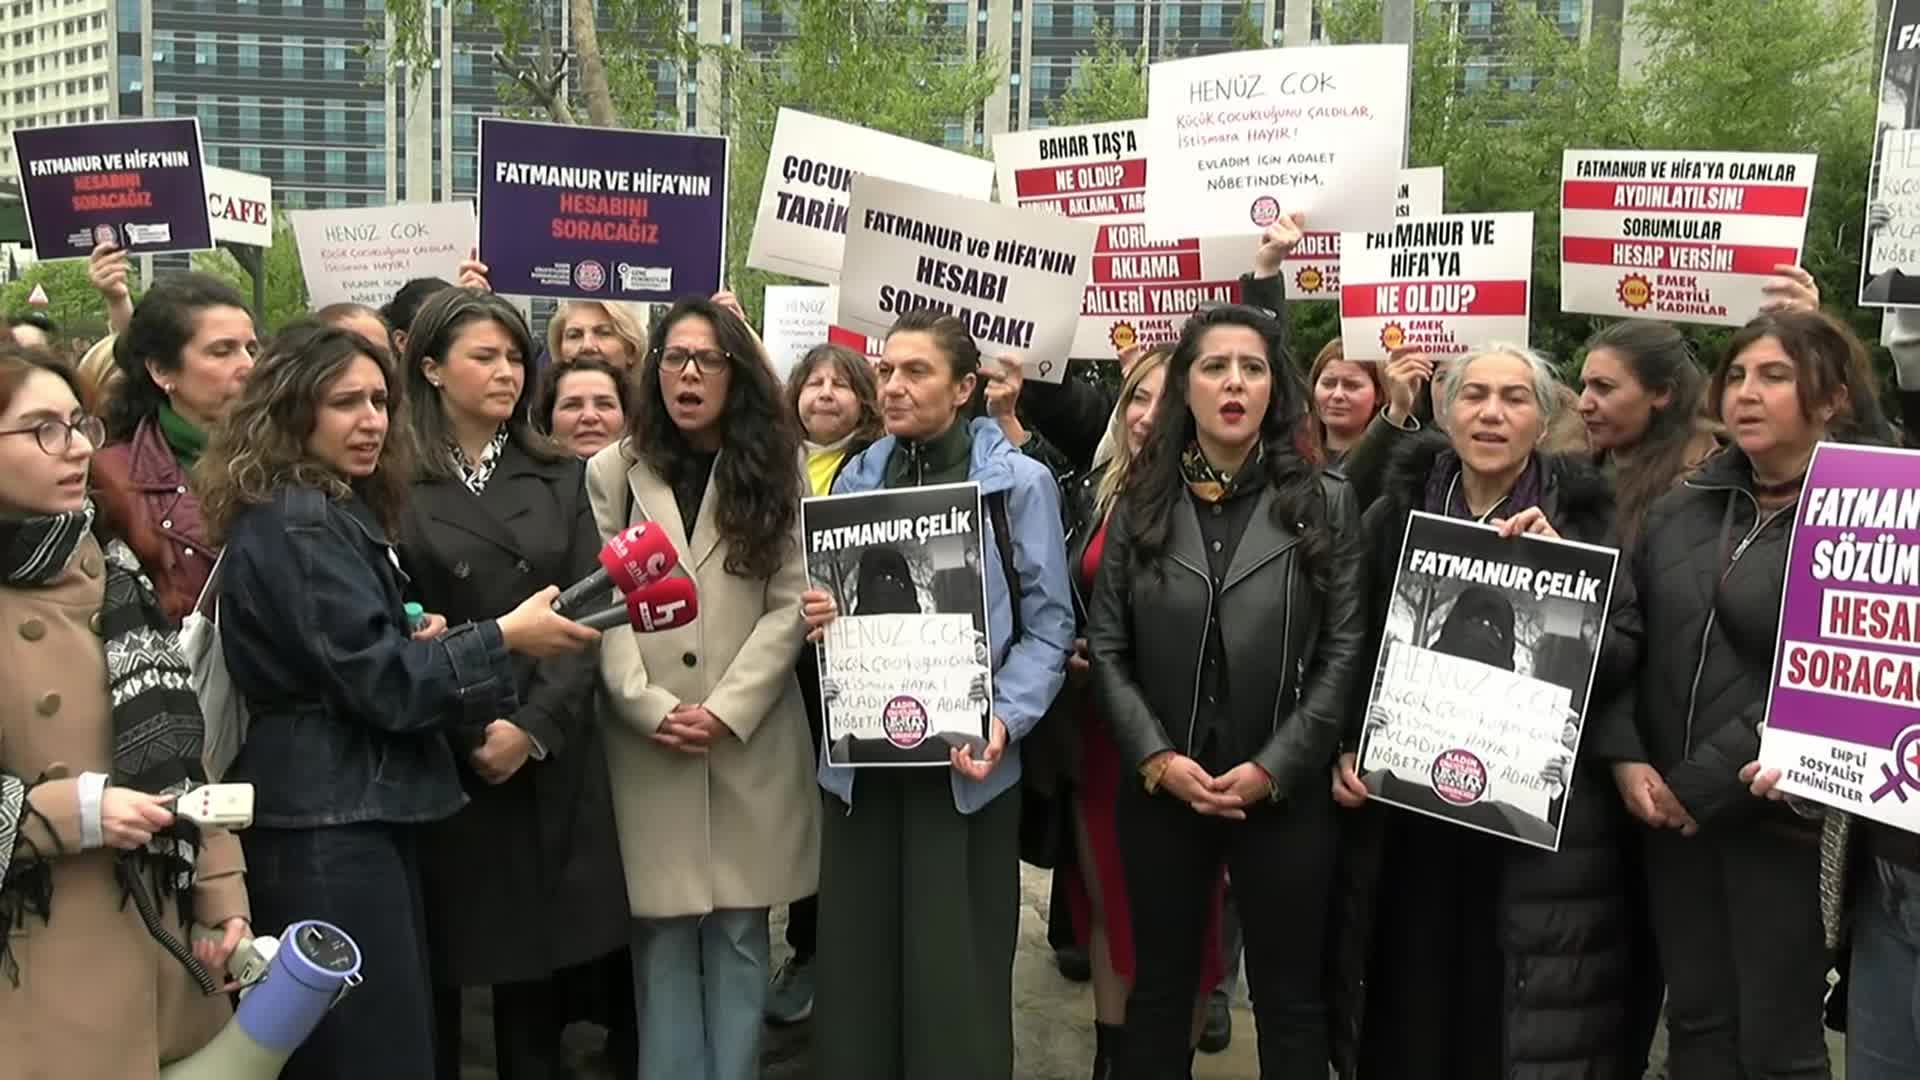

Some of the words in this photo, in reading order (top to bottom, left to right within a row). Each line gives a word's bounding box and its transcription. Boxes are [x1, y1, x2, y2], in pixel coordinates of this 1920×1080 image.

[1190, 74, 1265, 104] HENÜZ
[1280, 72, 1336, 96] ÇOK
[1040, 134, 1089, 160] BAHAR
[1093, 130, 1137, 160] TAŞ'A
[30, 156, 102, 176] FATMANUR
[103, 153, 122, 170] VE
[125, 149, 190, 169] HİFA'NIN
[1198, 156, 1250, 171] EVLADIM
[1287, 152, 1336, 164] ADALET
[1576, 160, 1646, 178] FATMANUR
[1651, 161, 1666, 178] VE
[1671, 158, 1724, 180] HİFA'YA
[1729, 163, 1796, 182] OLANLAR
[496, 161, 601, 189] FATMANUR
[605, 171, 630, 191] VE
[633, 168, 711, 196] HİFA'NIN
[1056, 169, 1074, 191] NE
[1078, 165, 1124, 189] OLDU?
[209, 193, 267, 226] CAFE
[560, 193, 648, 217] HESABINI
[1069, 195, 1119, 216] AKLAMA,
[1613, 185, 1745, 211] AYDINLATILSIN!
[325, 224, 378, 242] HENÜZ
[552, 218, 659, 244] SORACAĞIZ
[1471, 220, 1495, 245] VE
[1622, 217, 1722, 240] SORUMLULAR
[864, 209, 963, 253] FATMANUR
[967, 237, 990, 258] ve
[994, 240, 1077, 276] HİFA'NIN
[1112, 256, 1180, 279] AKLAMA
[1391, 248, 1460, 277] HİFA'YA
[1613, 243, 1665, 268] HESAP
[1669, 245, 1734, 272] VERSİN!
[916, 255, 1009, 304] HESABI
[1656, 275, 1697, 288] EMEK
[1376, 286, 1399, 314] NE
[1405, 284, 1476, 313] OLDU?
[1656, 288, 1710, 303] PARTİLİ
[1656, 302, 1728, 316] KADINLAR
[1409, 320, 1443, 333] EMEK
[813, 518, 913, 553] FATMANUR
[917, 507, 972, 544] ÇELİK
[1410, 549, 1530, 592] FATMANUR
[1534, 570, 1600, 603] ÇELİK
[1787, 647, 1920, 702] SORACA
[1800, 755, 1864, 784] SOSYALİST
[1787, 769, 1863, 803] FEMİNİSTLER
